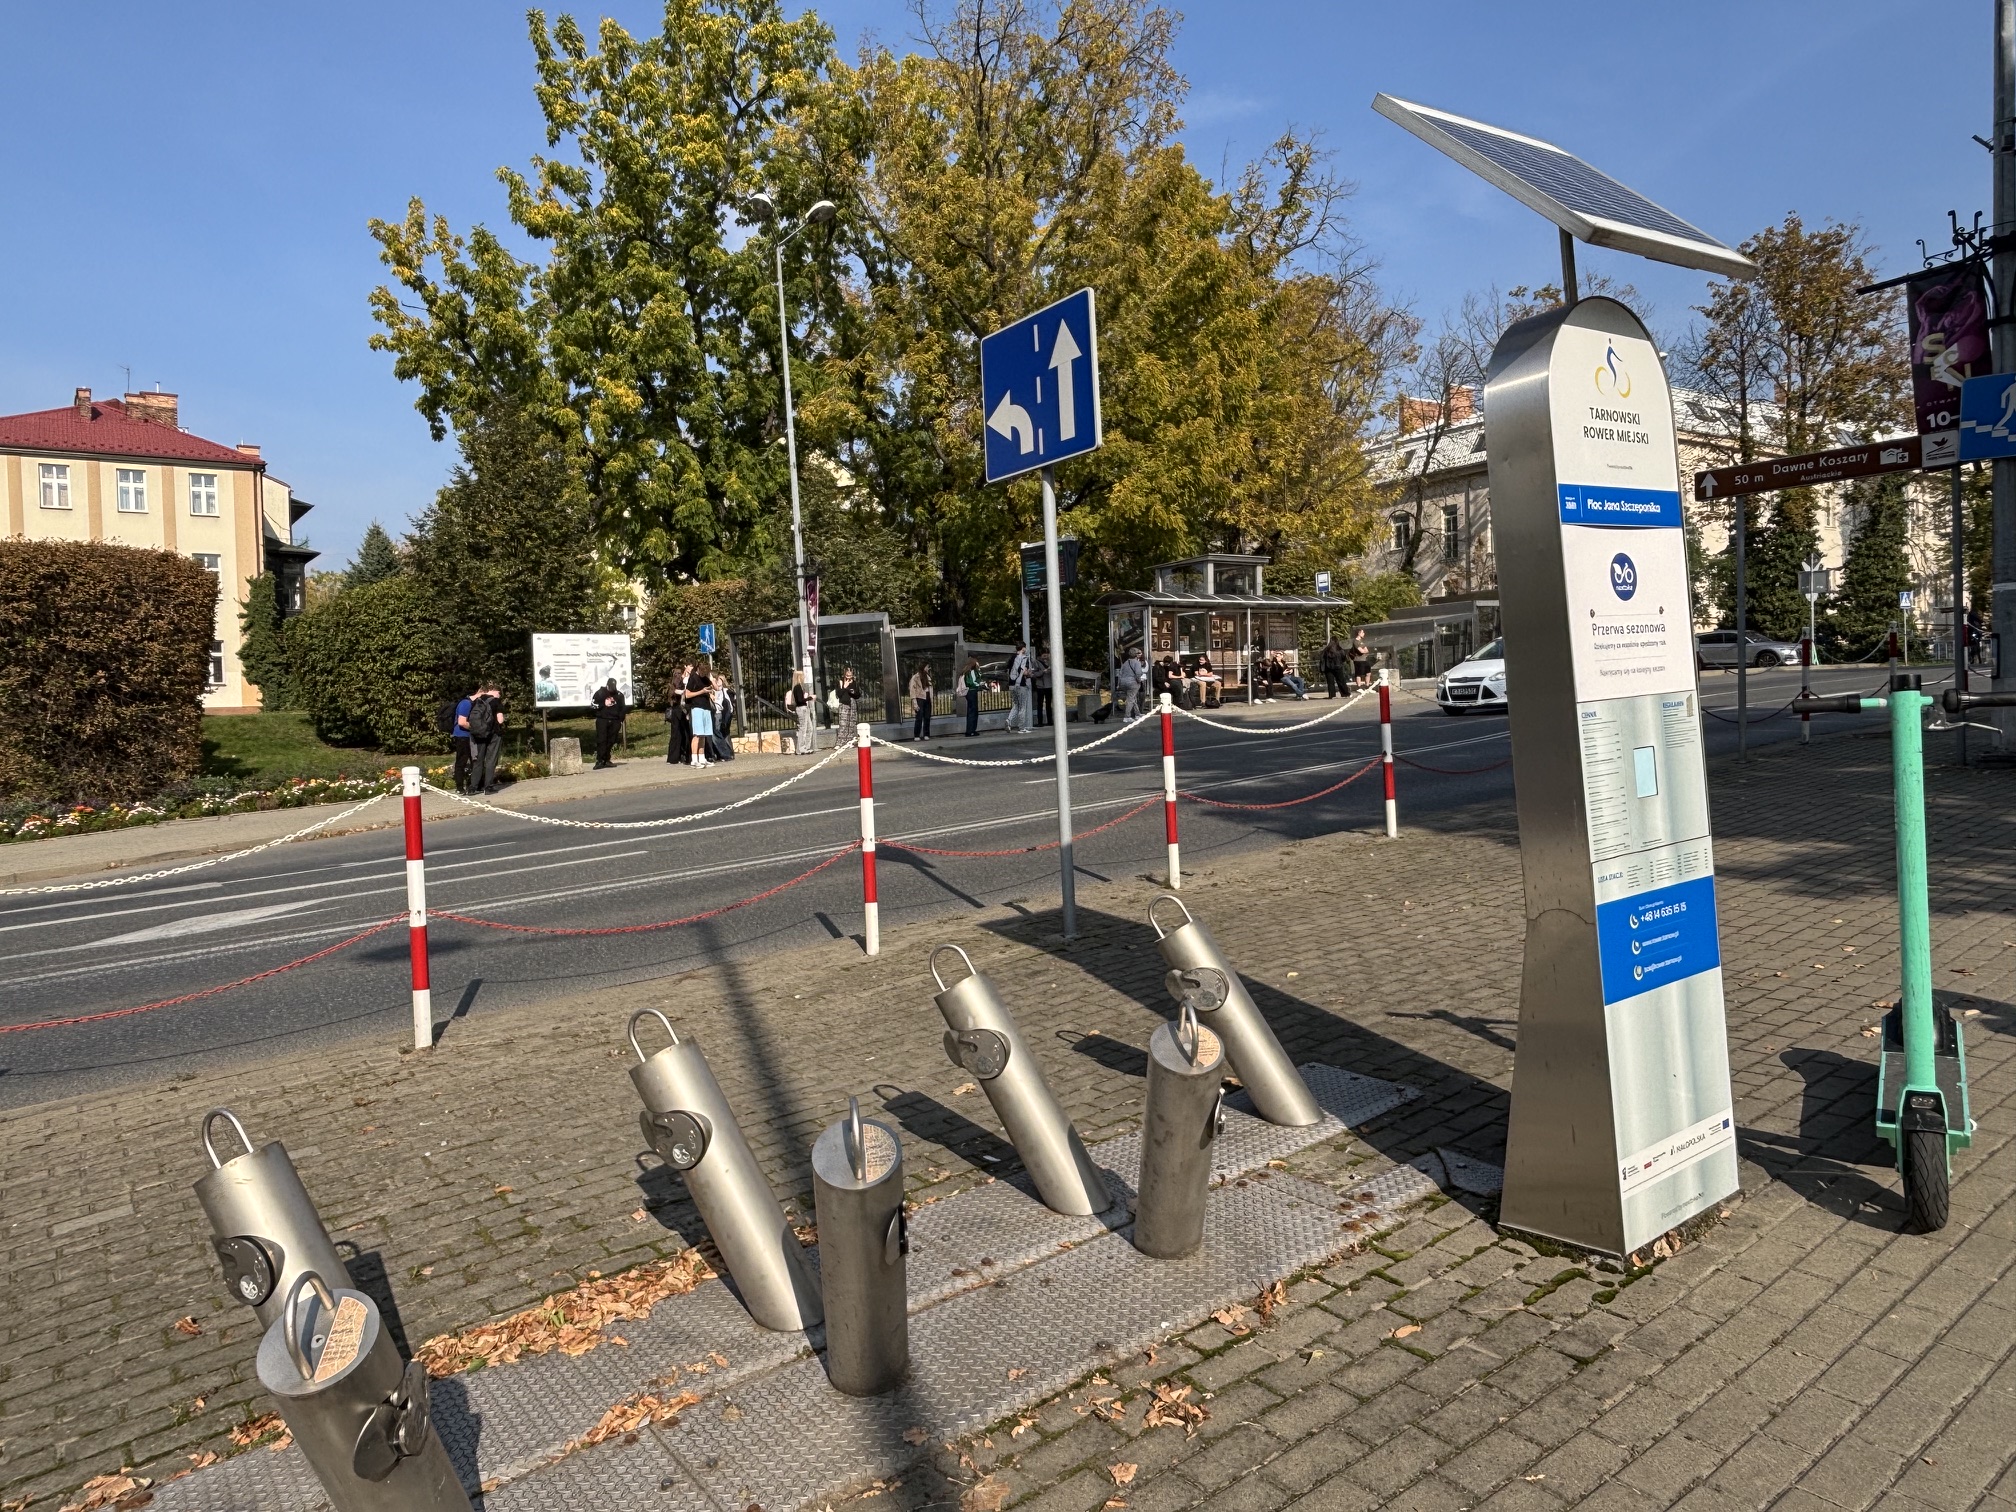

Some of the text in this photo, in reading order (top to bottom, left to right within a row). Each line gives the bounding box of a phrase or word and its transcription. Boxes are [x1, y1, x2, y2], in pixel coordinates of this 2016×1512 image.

[1589, 407, 1641, 425] TARNOWSKI
[1583, 426, 1649, 445] ROWER MIEJSKI
[1734, 451, 1869, 486] 50 m Dawne Koszary
[1800, 470, 1842, 482] Austriackie
[1587, 498, 1602, 510] Plac
[1604, 499, 1620, 511] Jana
[1591, 622, 1666, 636] Przerwa sezonowa
